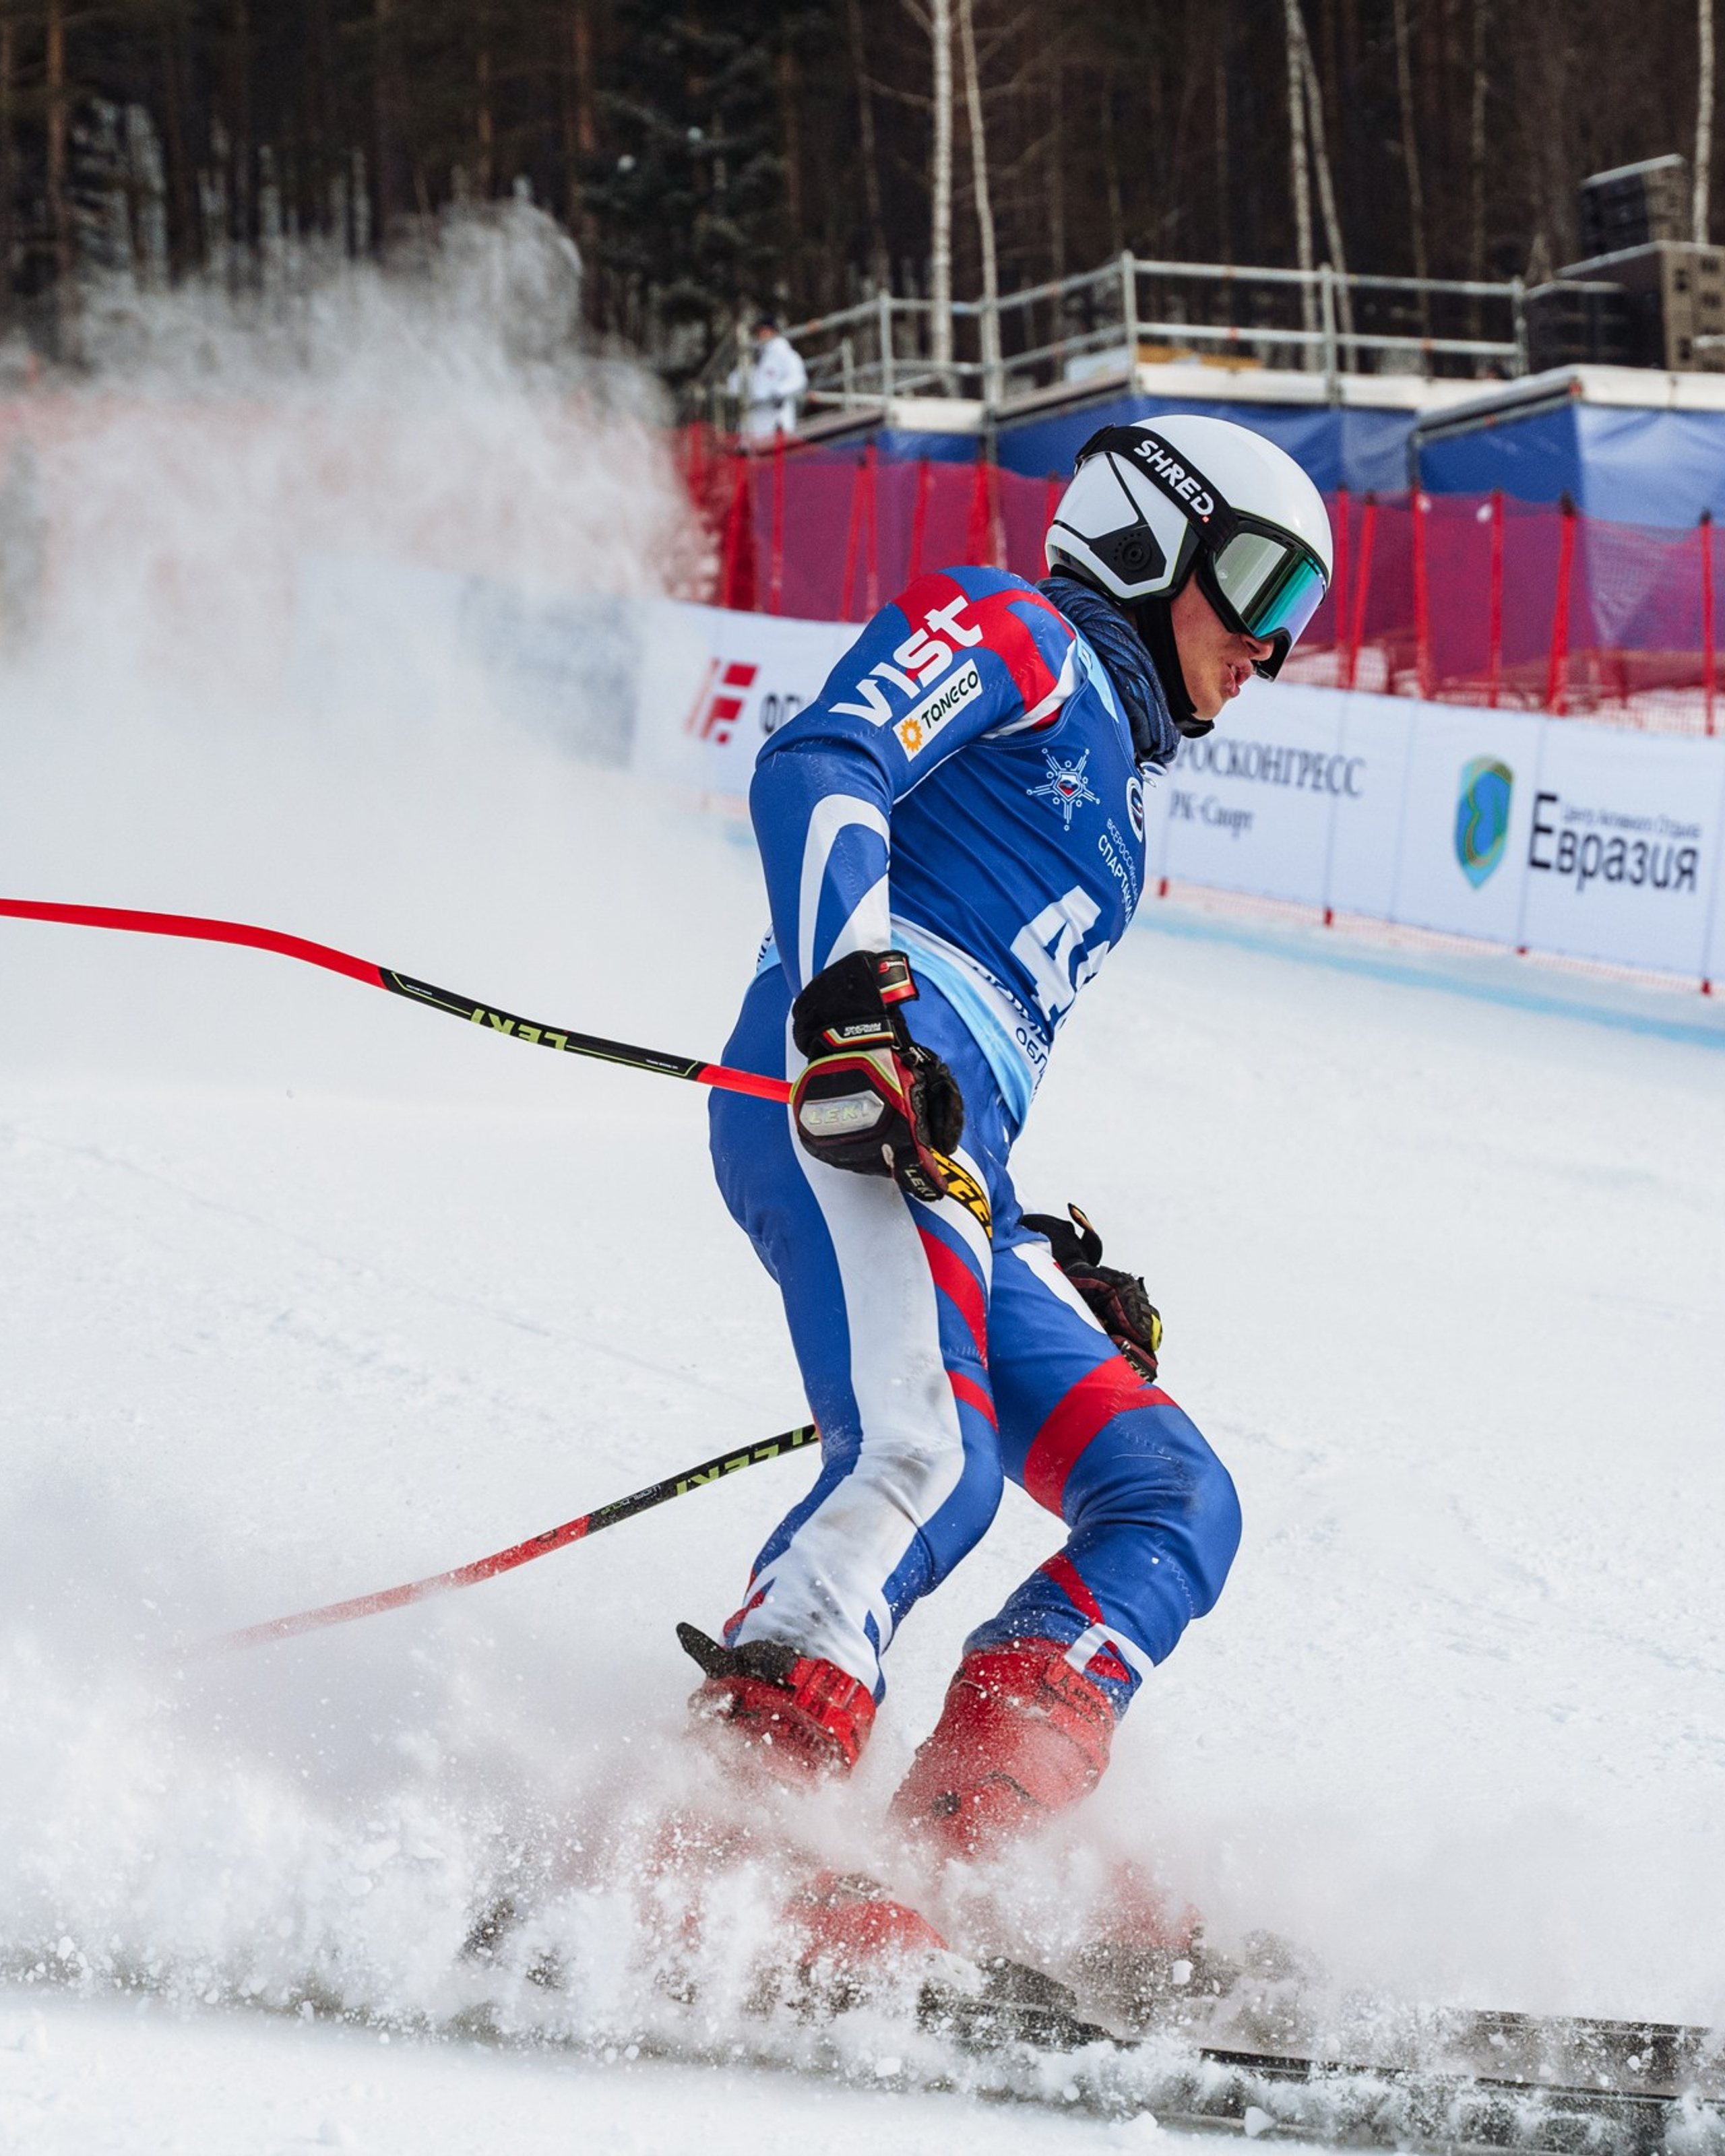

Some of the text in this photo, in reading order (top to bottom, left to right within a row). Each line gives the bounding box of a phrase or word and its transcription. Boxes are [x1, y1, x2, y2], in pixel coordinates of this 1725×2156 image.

[1530, 792, 1700, 893] Евразия
[470, 1008, 568, 1051] LEKI
[809, 1100, 869, 1125] LEKI
[904, 1168, 937, 1197] LEKI
[676, 1443, 779, 1496] LEKI
